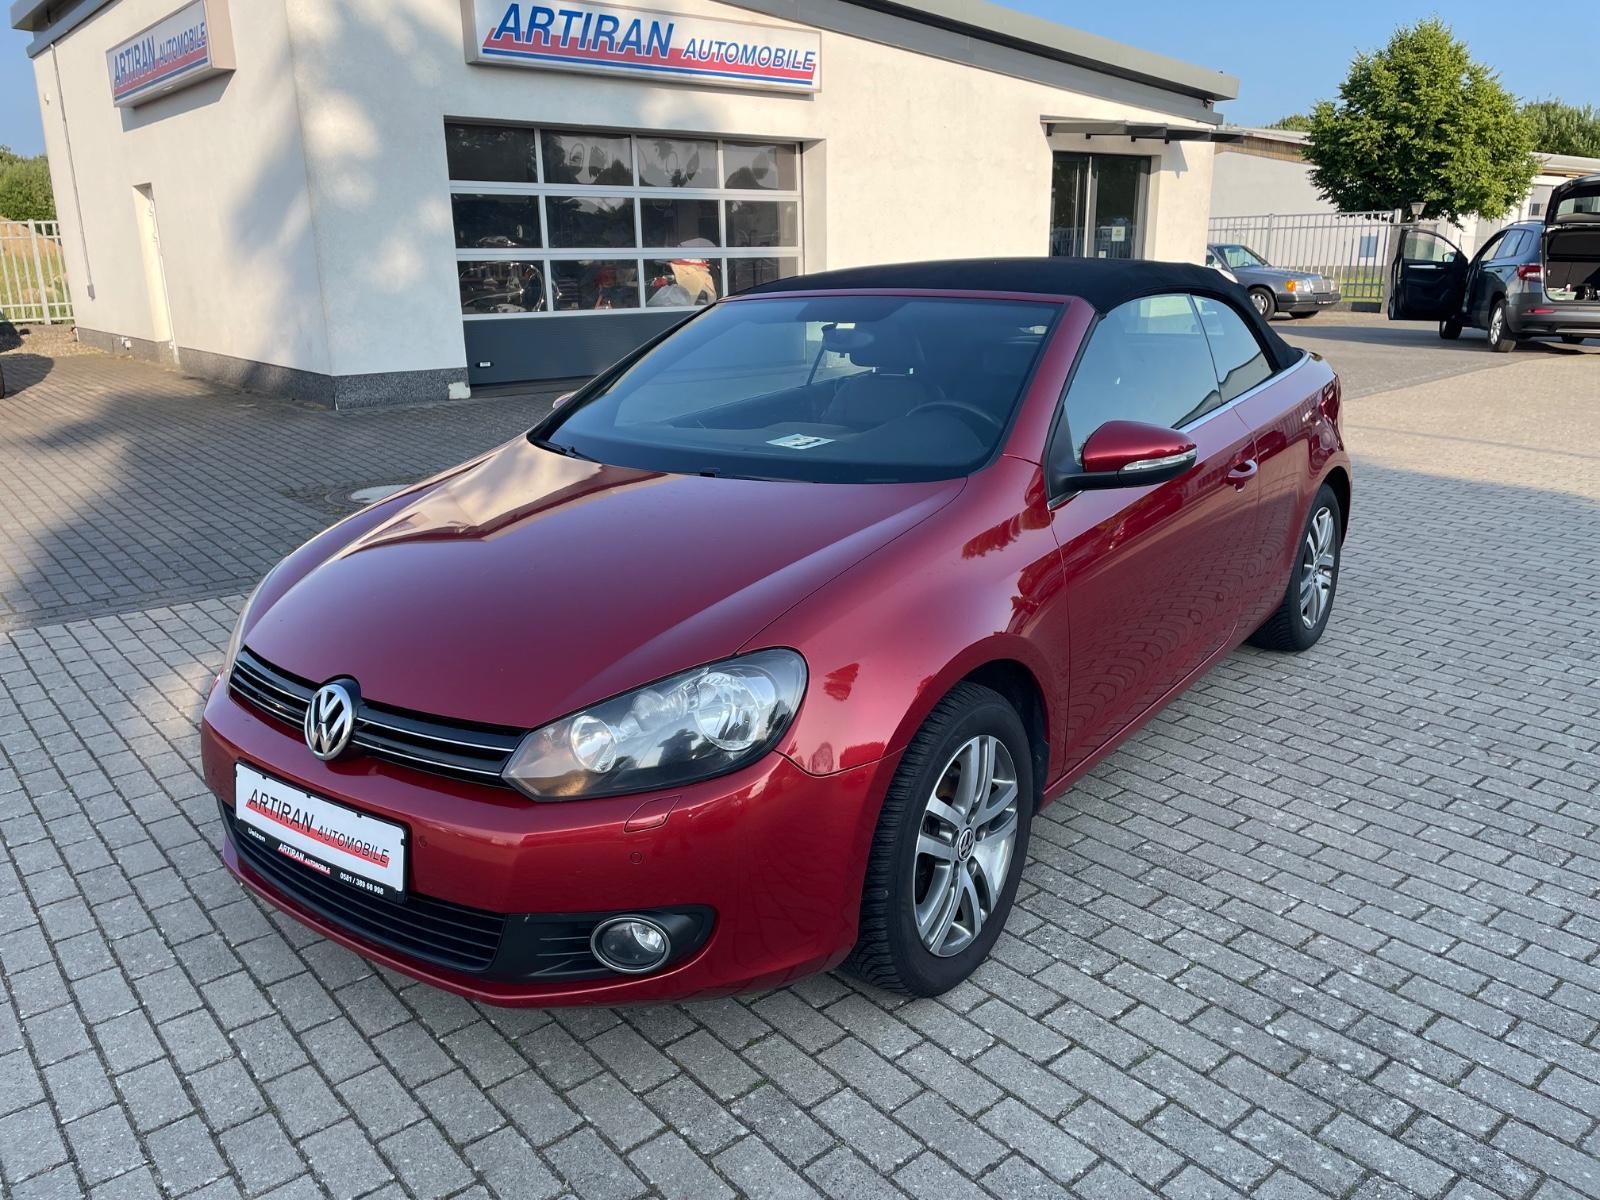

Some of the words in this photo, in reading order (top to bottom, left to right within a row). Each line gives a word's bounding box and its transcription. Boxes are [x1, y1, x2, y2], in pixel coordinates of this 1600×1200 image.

[114, 35, 156, 83] ARTIRAN
[160, 22, 206, 64] AUTOMOBILE
[494, 2, 674, 58] ARTIRAN
[682, 38, 816, 72] AUTOMOBILE
[249, 788, 315, 833] ARTIRAN
[316, 825, 390, 864] AUTOMOBILE
[279, 843, 305, 861] ARTIRAN
[340, 872, 352, 883] 0581
